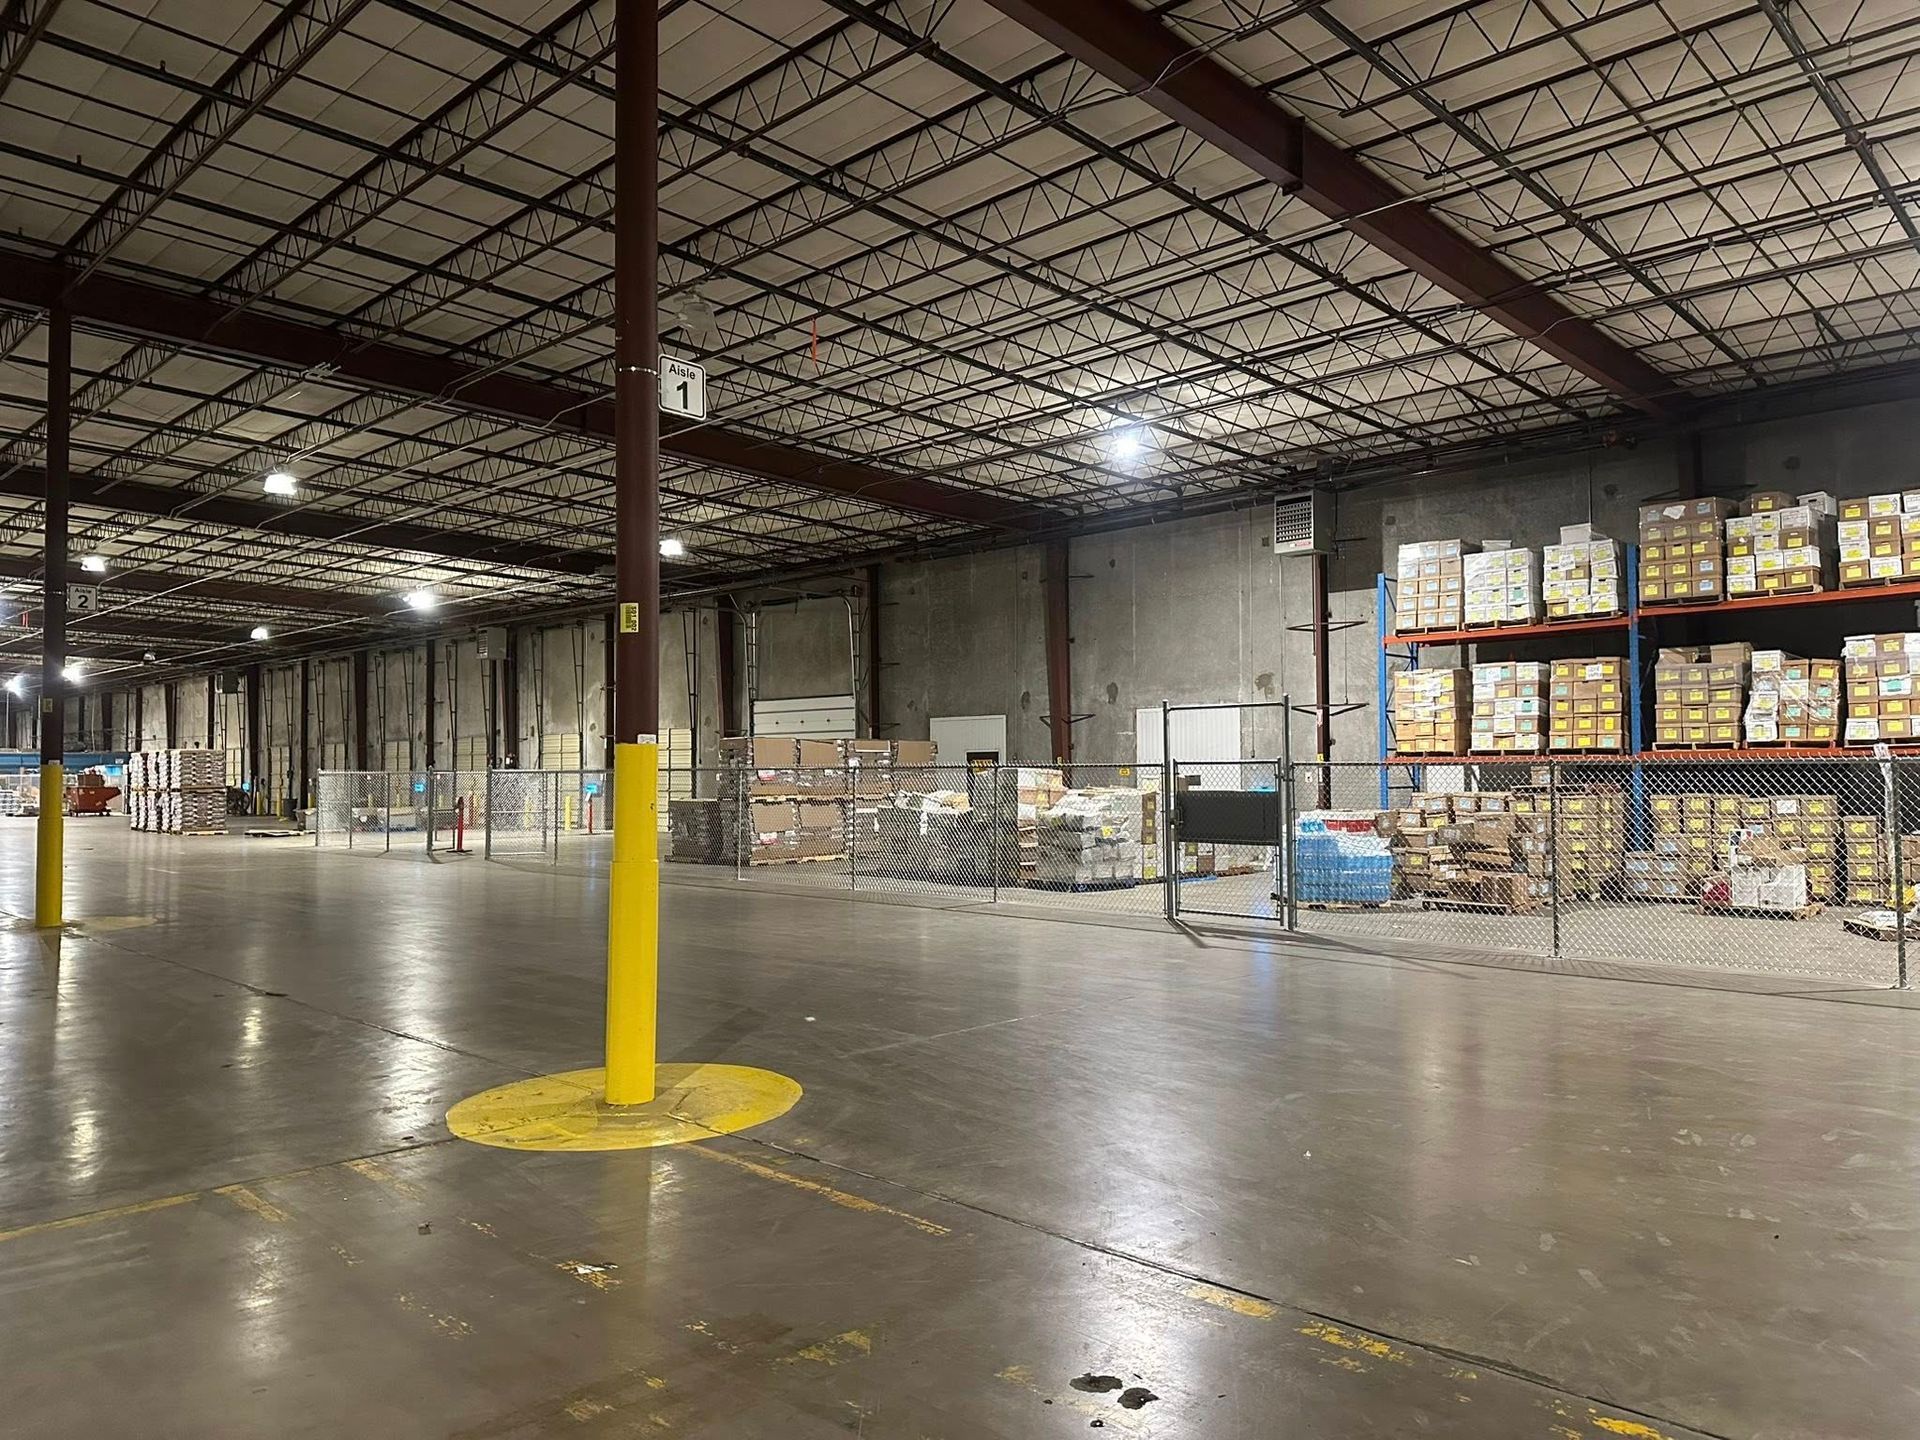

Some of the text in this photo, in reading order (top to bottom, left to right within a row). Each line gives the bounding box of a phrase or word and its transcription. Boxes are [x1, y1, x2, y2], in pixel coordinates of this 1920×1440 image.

[669, 363, 695, 380] Aisle
[676, 381, 688, 410] 1
[78, 595, 88, 608] 2
